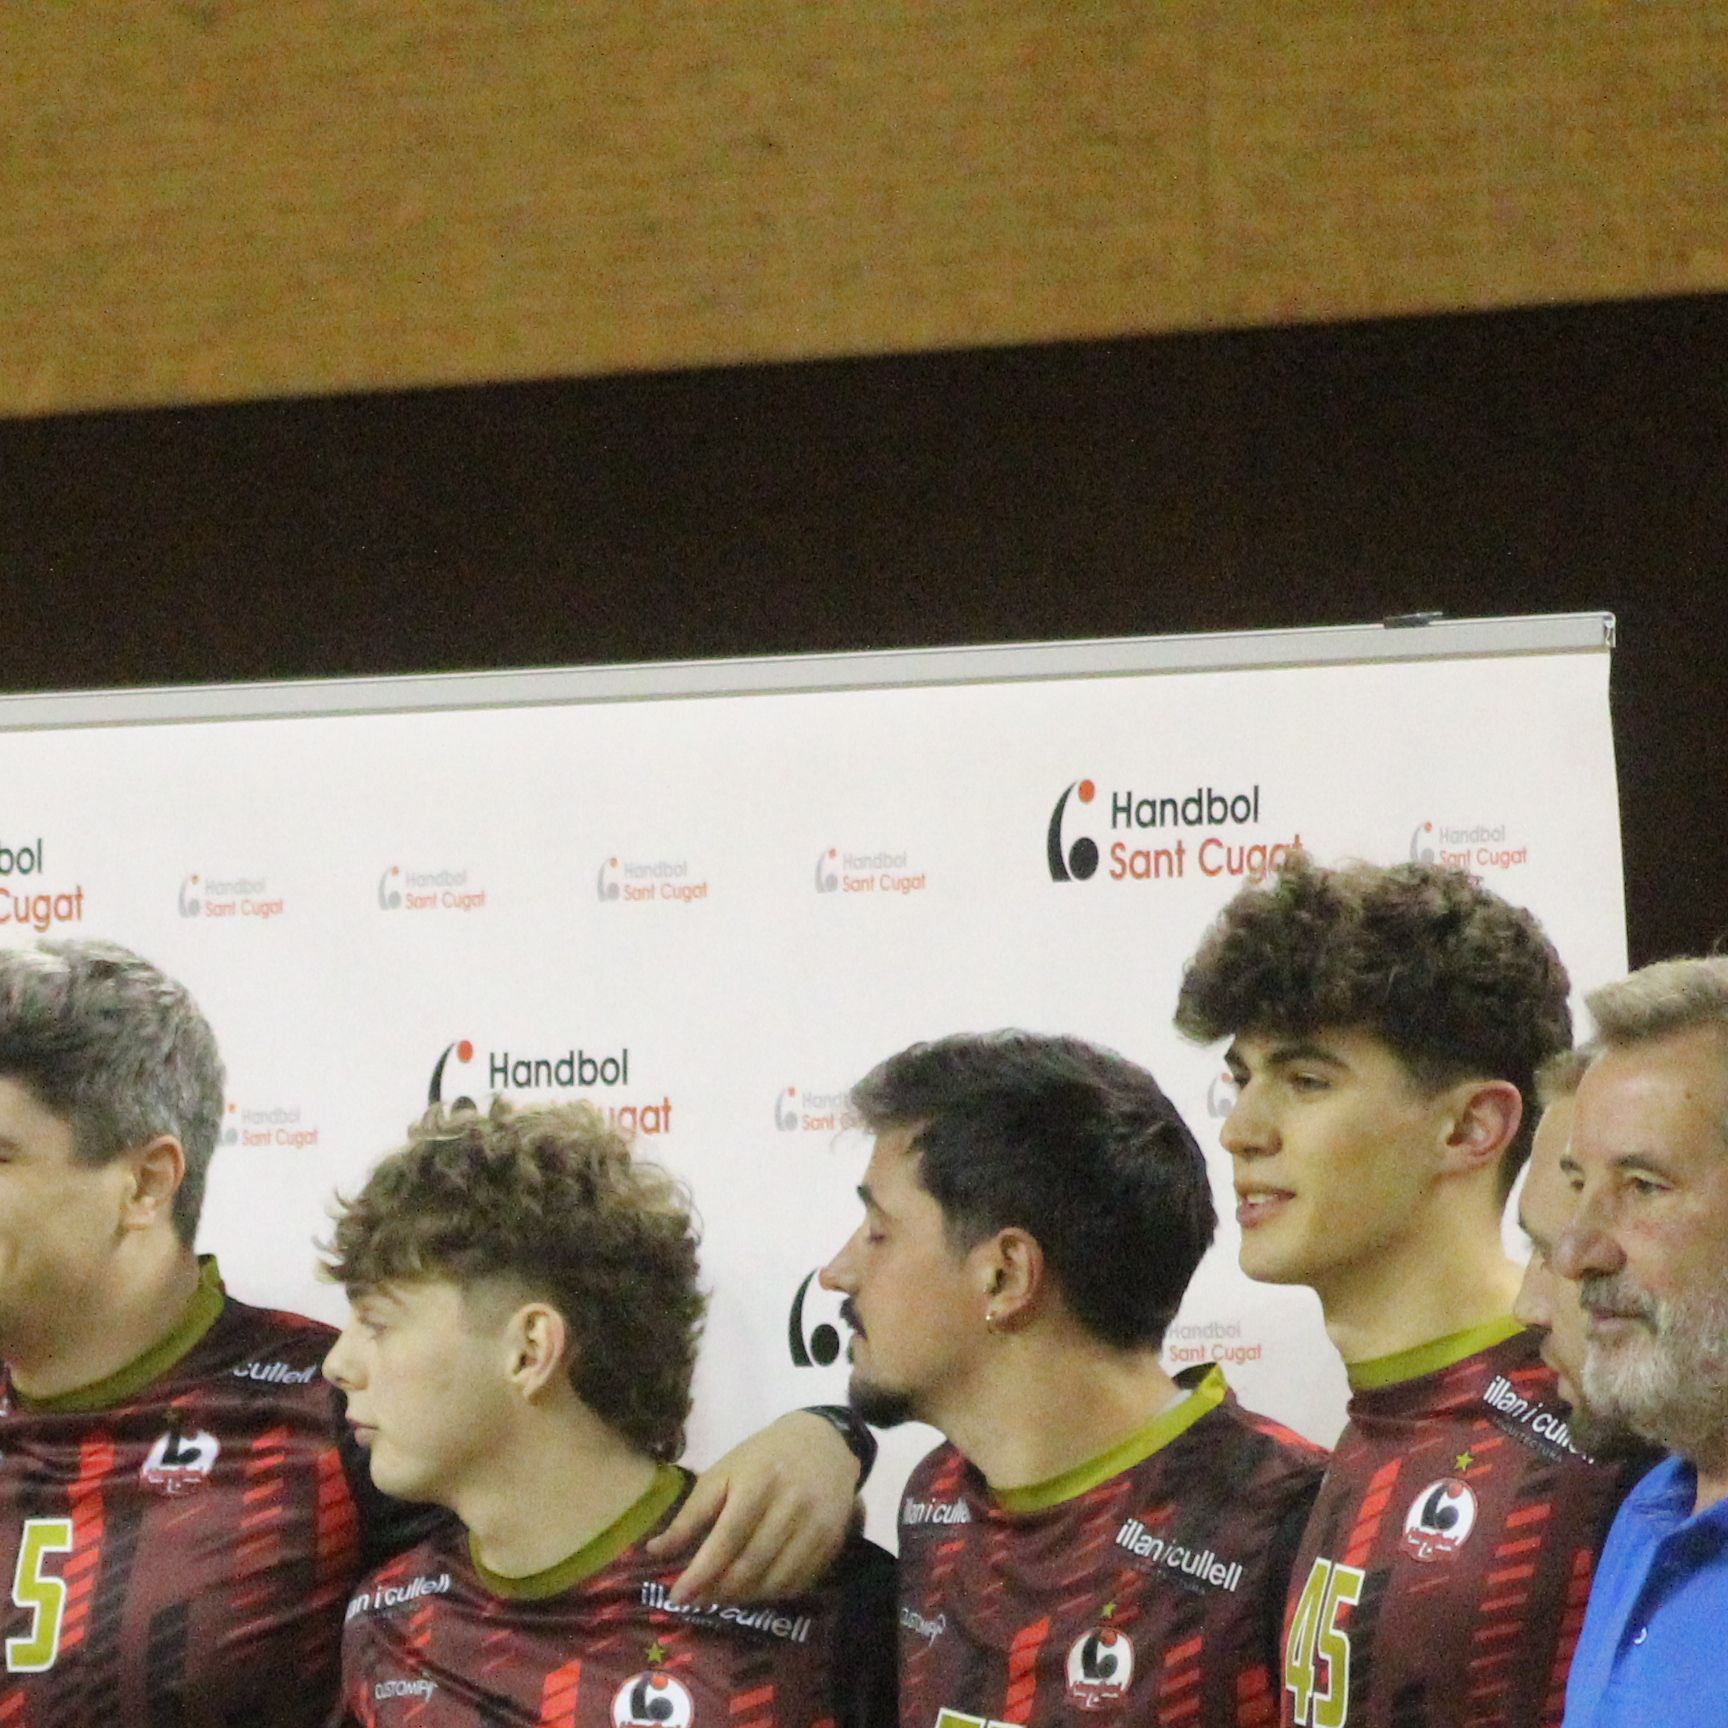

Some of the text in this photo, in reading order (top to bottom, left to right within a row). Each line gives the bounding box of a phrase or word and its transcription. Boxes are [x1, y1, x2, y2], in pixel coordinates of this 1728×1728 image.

[1112, 785, 1260, 829] Handbol
[624, 860, 687, 880] Handbol
[843, 850, 907, 870] Handbol
[1110, 837, 1186, 880] Sant
[624, 881, 708, 904] Sant Cugat
[843, 871, 927, 895] Sant Cugat
[490, 1049, 629, 1089] Handbol
[1483, 1375, 1529, 1418] illan
[1115, 1518, 1165, 1562] illan
[1166, 1546, 1243, 1593] cullell
[5, 1516, 74, 1673] 5
[384, 1573, 451, 1607] cullell
